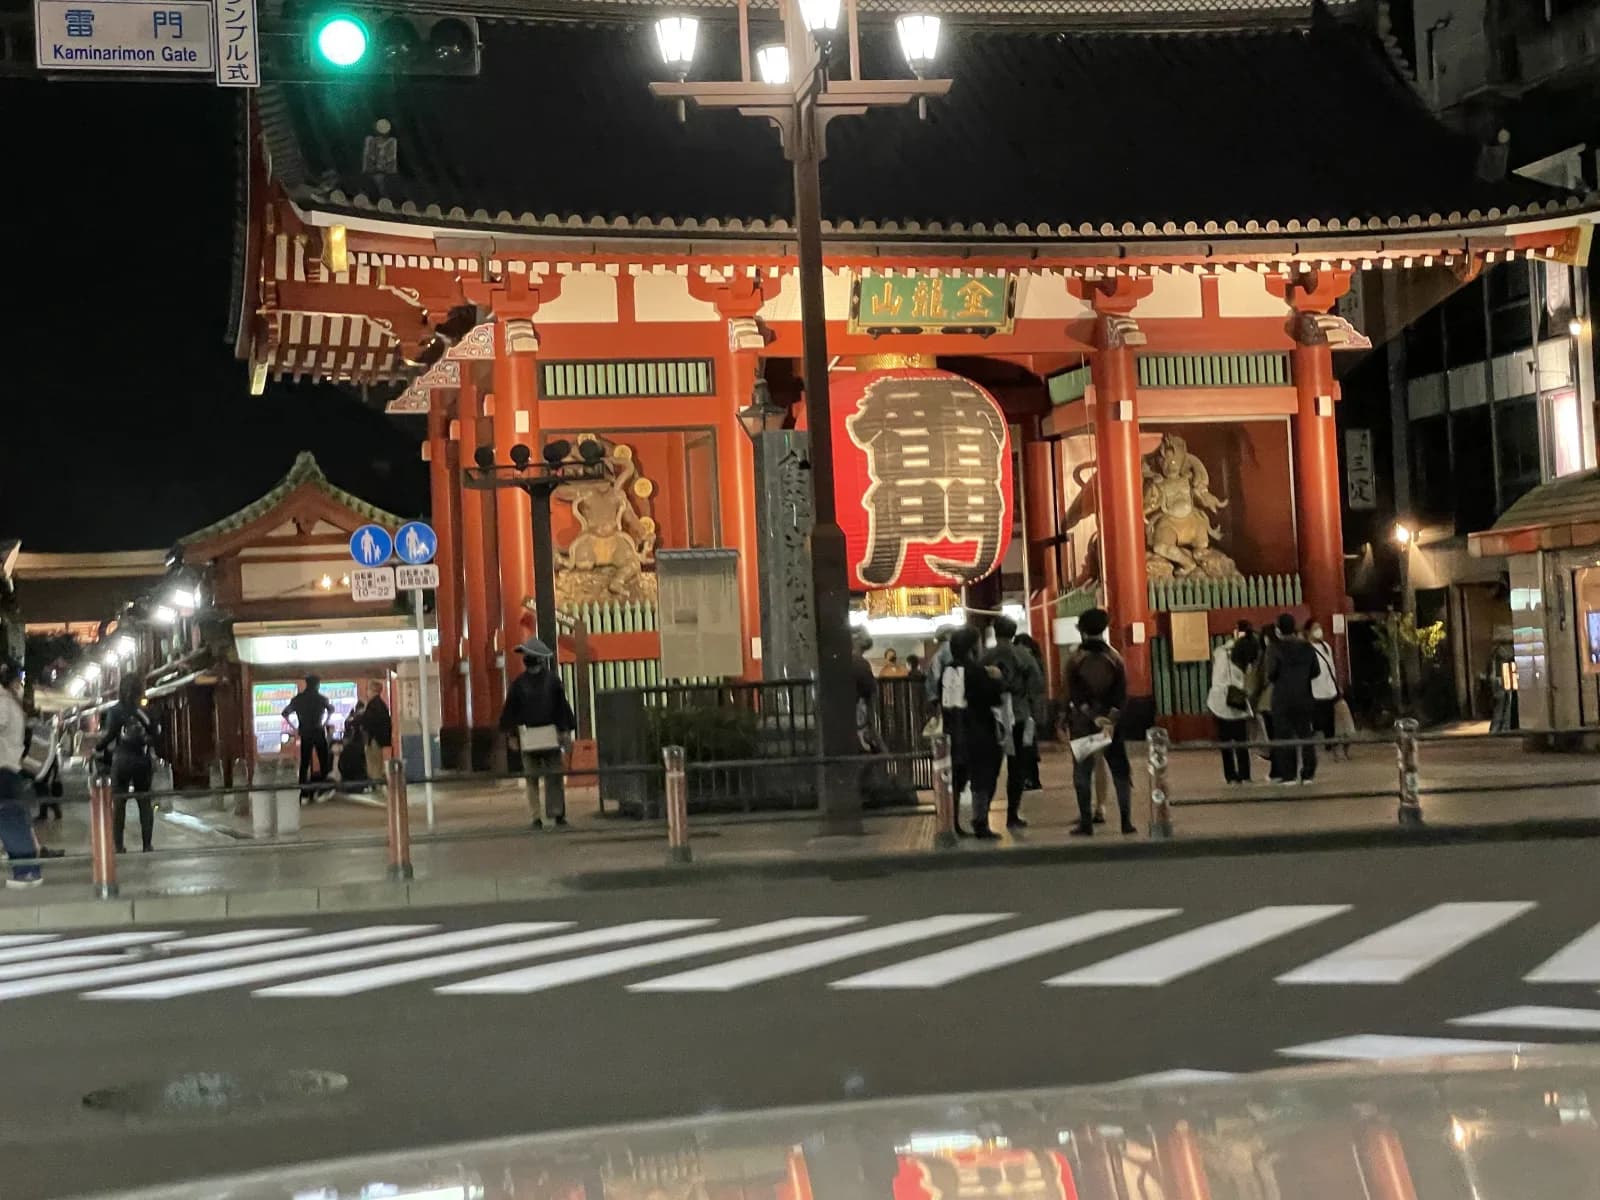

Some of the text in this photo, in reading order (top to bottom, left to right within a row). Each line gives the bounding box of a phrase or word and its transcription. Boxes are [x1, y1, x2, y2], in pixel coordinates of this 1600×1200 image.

[64, 10, 185, 39] 雷門
[224, 0, 249, 81] ンブル式
[53, 44, 197, 63] Kaminarimon Gate
[846, 376, 1006, 588] 雷門
